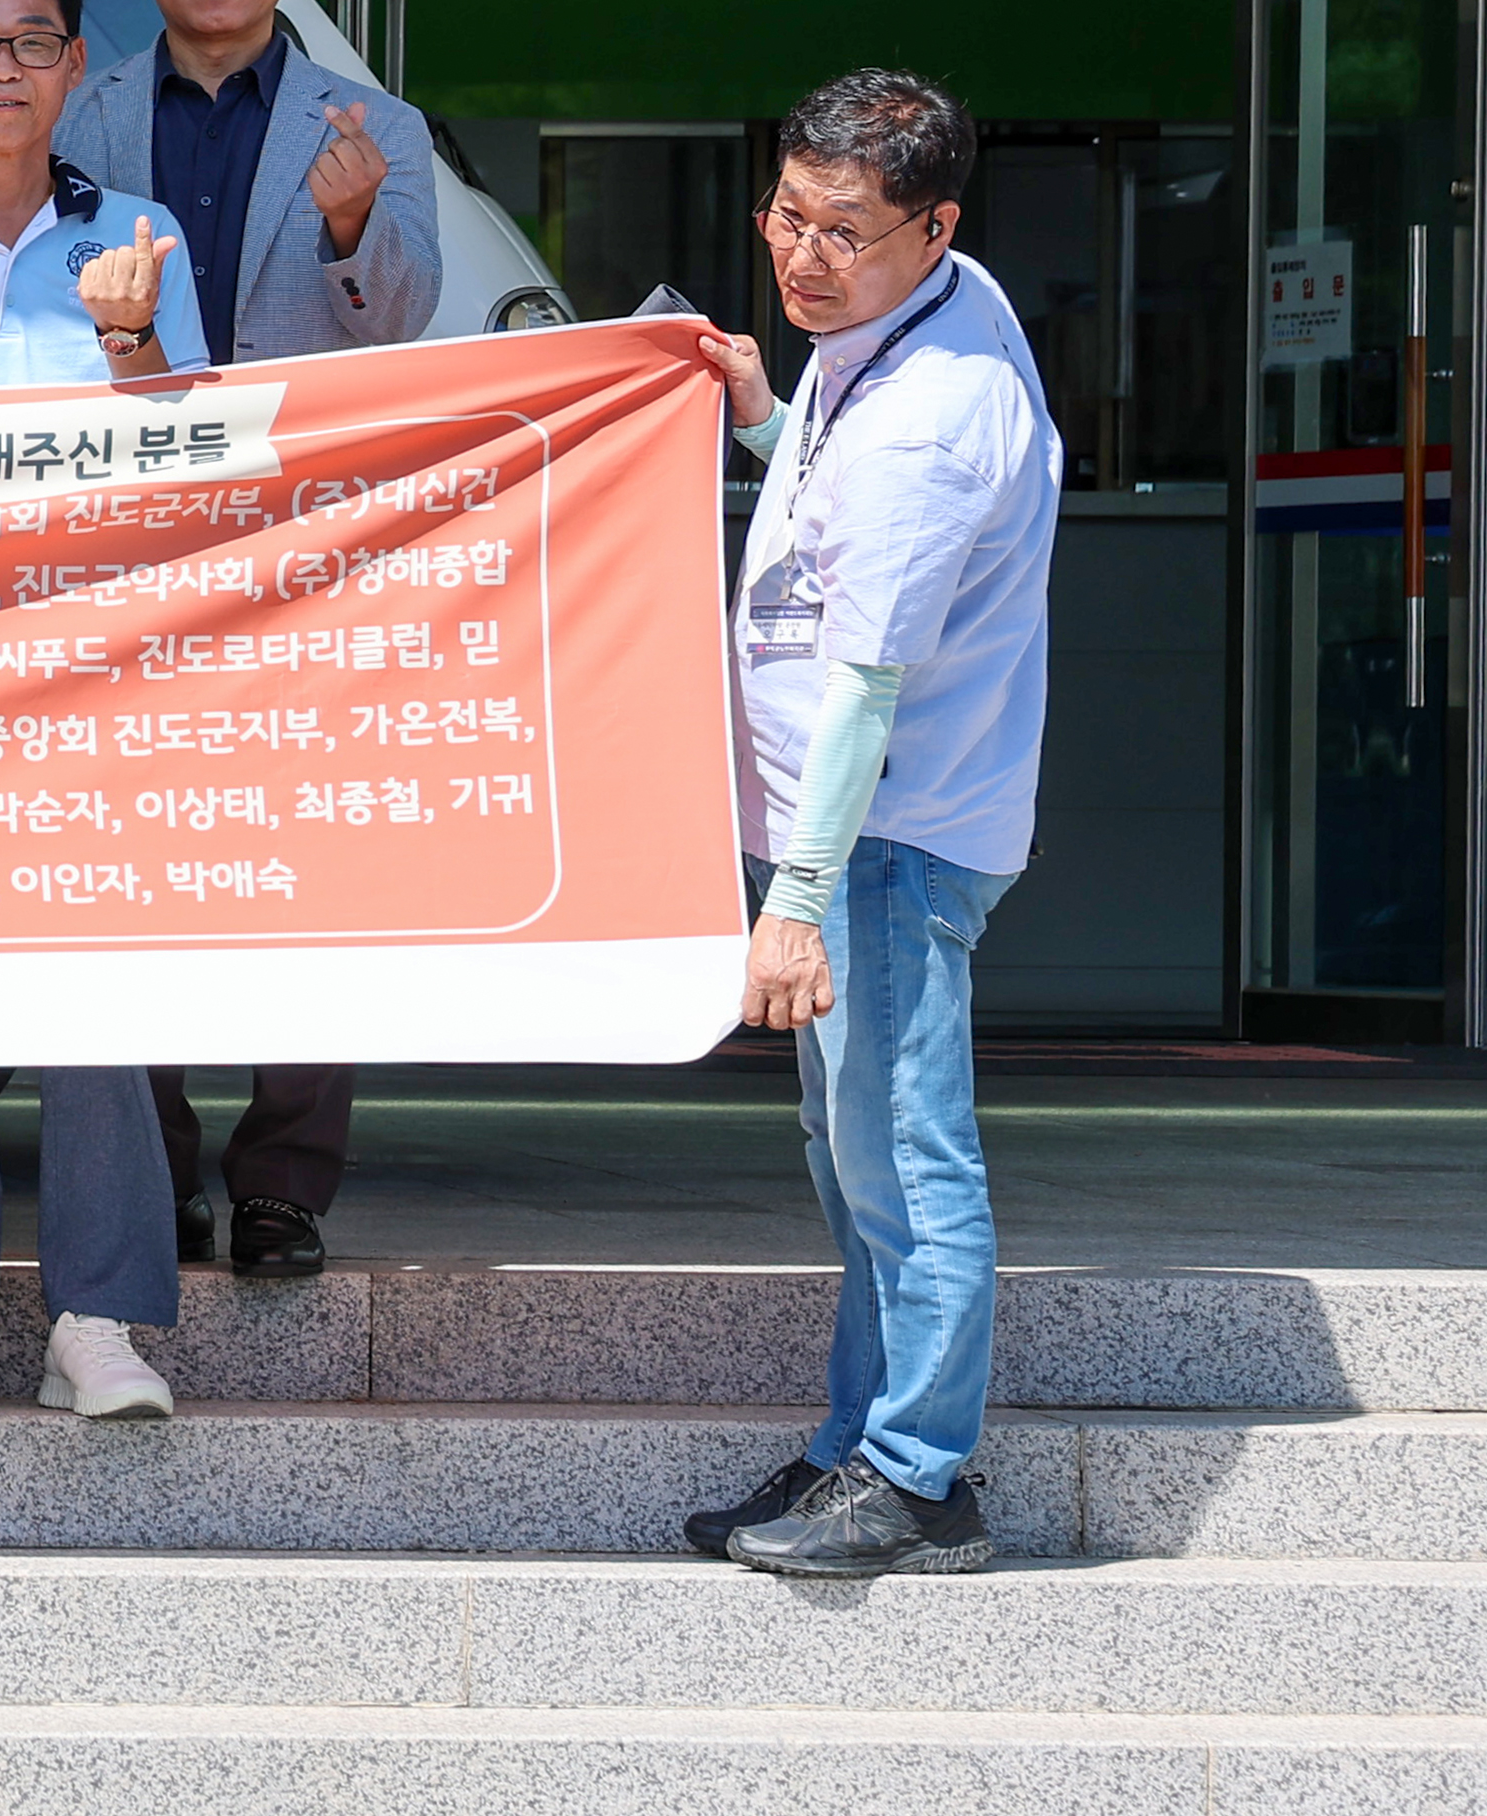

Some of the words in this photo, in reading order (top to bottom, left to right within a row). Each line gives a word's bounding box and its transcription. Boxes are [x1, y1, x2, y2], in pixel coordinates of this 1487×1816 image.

[132, 421, 232, 474] 분들
[63, 486, 275, 536] 진도군지부,
[290, 466, 499, 527] (주)대신건
[12, 555, 264, 611] 진도군약사회,
[274, 539, 513, 601] (주)청해종합
[136, 621, 445, 682] 진도로타리클럽,
[459, 620, 501, 667] 믿
[112, 707, 337, 758] 진도군지부,
[349, 696, 536, 747] 가온전복,
[135, 785, 281, 831] 이상태,
[294, 777, 436, 827] 최종철,
[448, 773, 536, 818] 기귀
[10, 861, 153, 906] 이인자,
[166, 857, 299, 902] 박애숙
